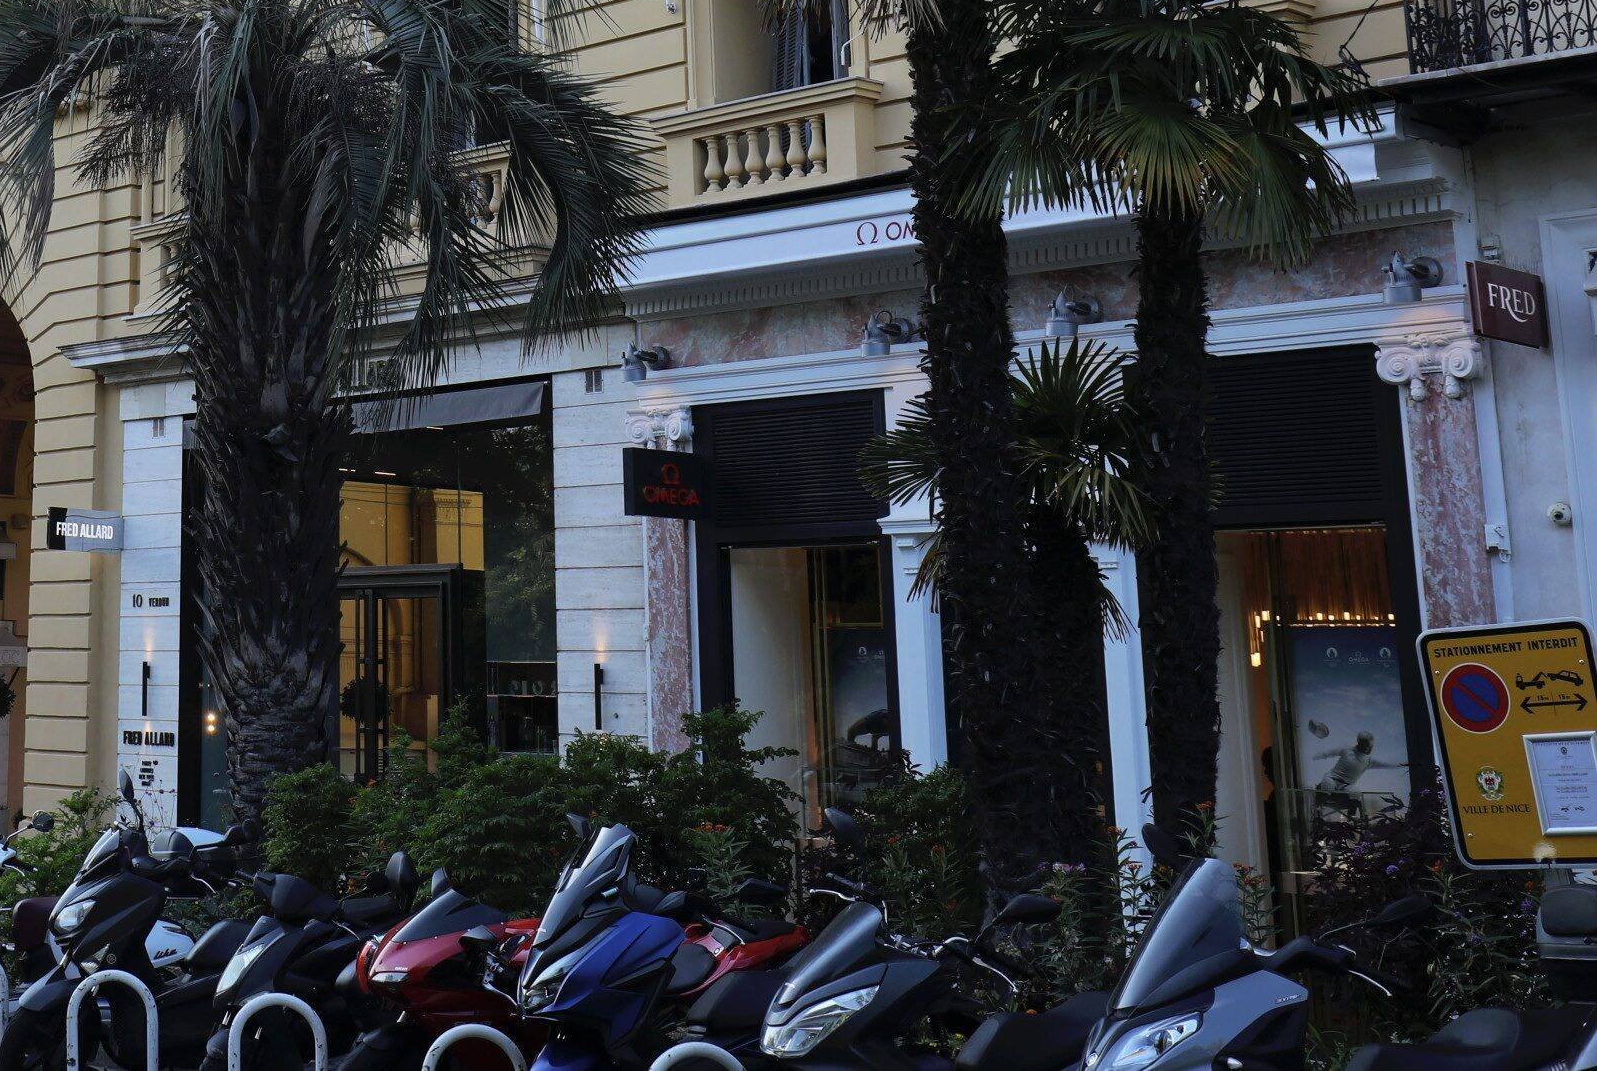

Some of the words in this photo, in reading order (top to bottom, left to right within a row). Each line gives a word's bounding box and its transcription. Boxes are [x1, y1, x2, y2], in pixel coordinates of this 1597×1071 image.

[1487, 283, 1536, 323] FRED
[643, 486, 701, 506] OMEGA
[56, 522, 79, 537] FRED
[80, 523, 114, 540] ALLARD
[132, 594, 143, 607] 10
[1433, 641, 1523, 659] STATIONNEMENT
[1527, 637, 1578, 651] INTERDIT
[1462, 804, 1489, 815] VILLE
[1491, 804, 1506, 814] DE
[1507, 803, 1532, 814] NICE
